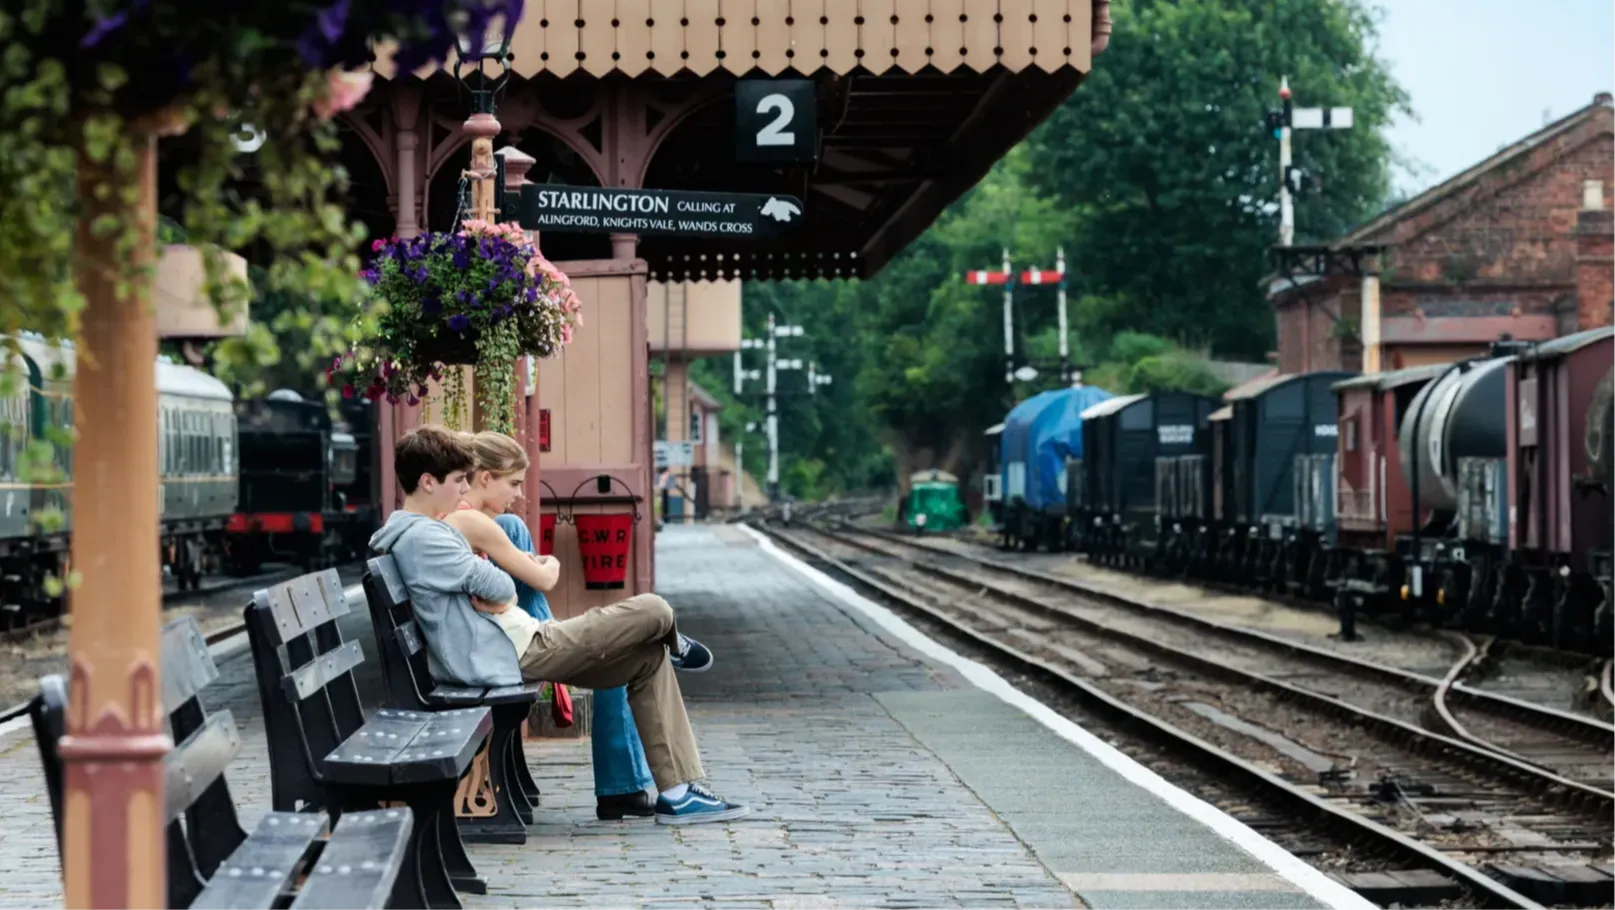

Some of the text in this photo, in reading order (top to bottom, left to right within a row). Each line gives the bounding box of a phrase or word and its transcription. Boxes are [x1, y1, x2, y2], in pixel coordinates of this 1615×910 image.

[756, 93, 795, 146] 2
[538, 190, 736, 214] STARLINGTON CALLING AT
[537, 213, 753, 234] ALINGFORD, KNIGHTS VALE, WANDS CROSS
